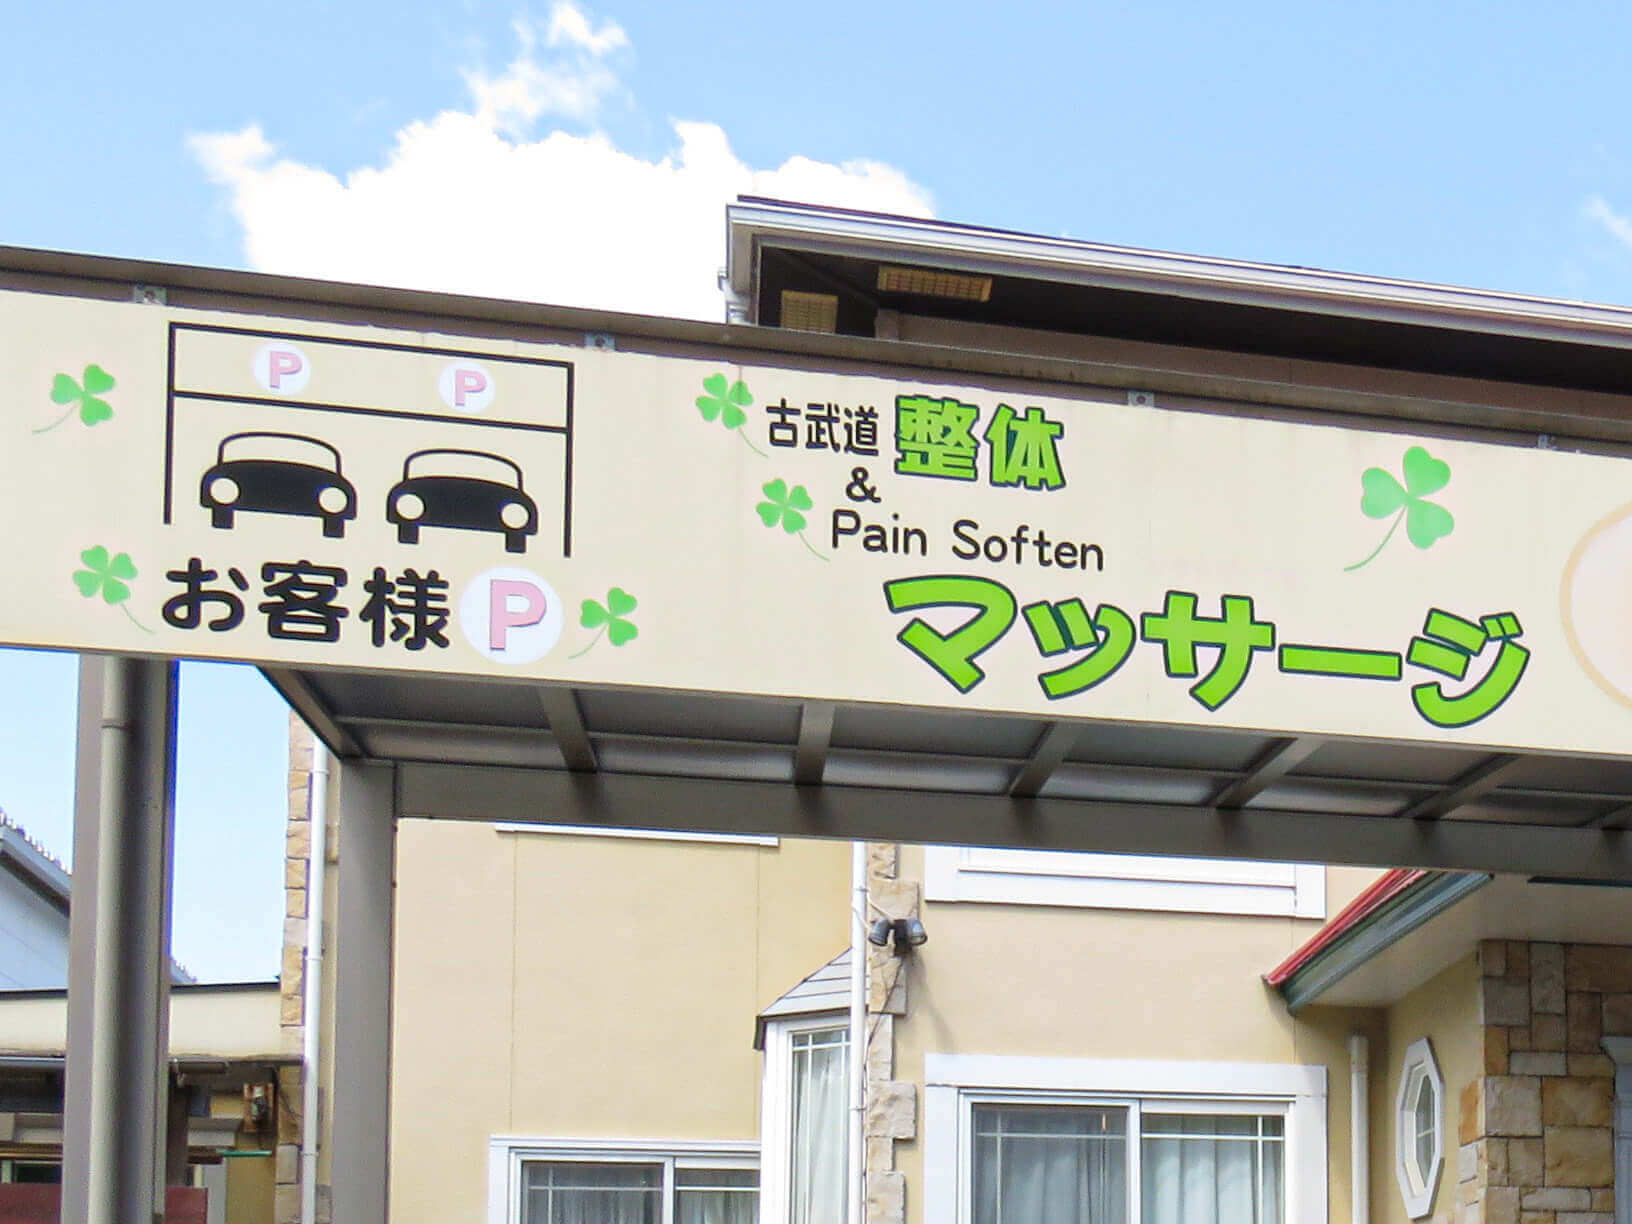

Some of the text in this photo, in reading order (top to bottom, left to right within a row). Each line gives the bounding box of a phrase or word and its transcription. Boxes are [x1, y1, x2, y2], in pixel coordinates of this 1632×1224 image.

[268, 349, 303, 390] P
[454, 368, 488, 407] P
[766, 393, 1068, 492] 古武道 整体
[845, 466, 882, 504] &
[831, 508, 1105, 572] Pain Soften
[160, 556, 549, 653] お客様 P
[881, 573, 1532, 730] マッサージ
